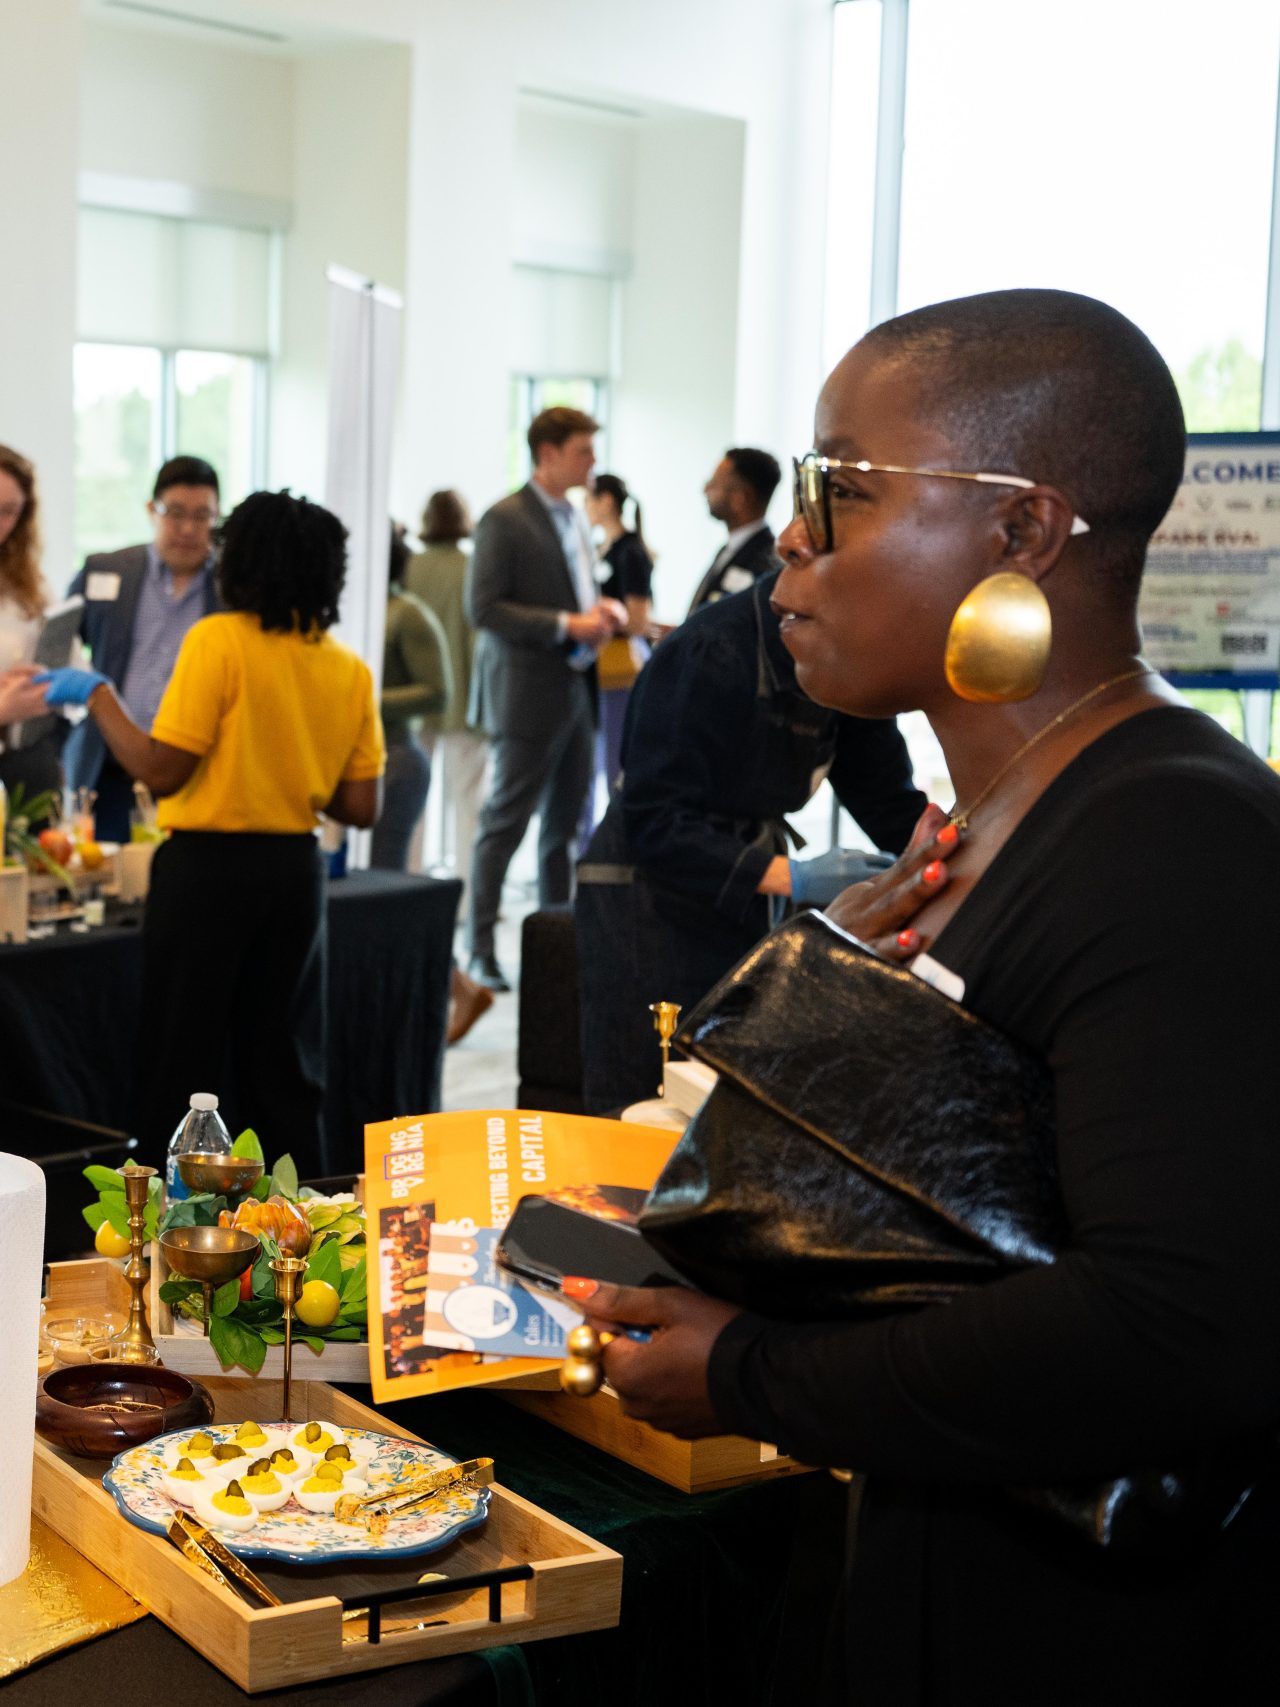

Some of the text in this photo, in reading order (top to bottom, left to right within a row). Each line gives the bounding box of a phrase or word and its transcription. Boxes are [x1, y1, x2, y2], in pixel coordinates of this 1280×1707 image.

[1185, 460, 1280, 485] COME
[486, 1117, 508, 1170] BEYOND
[518, 1115, 547, 1183] CAPITAL
